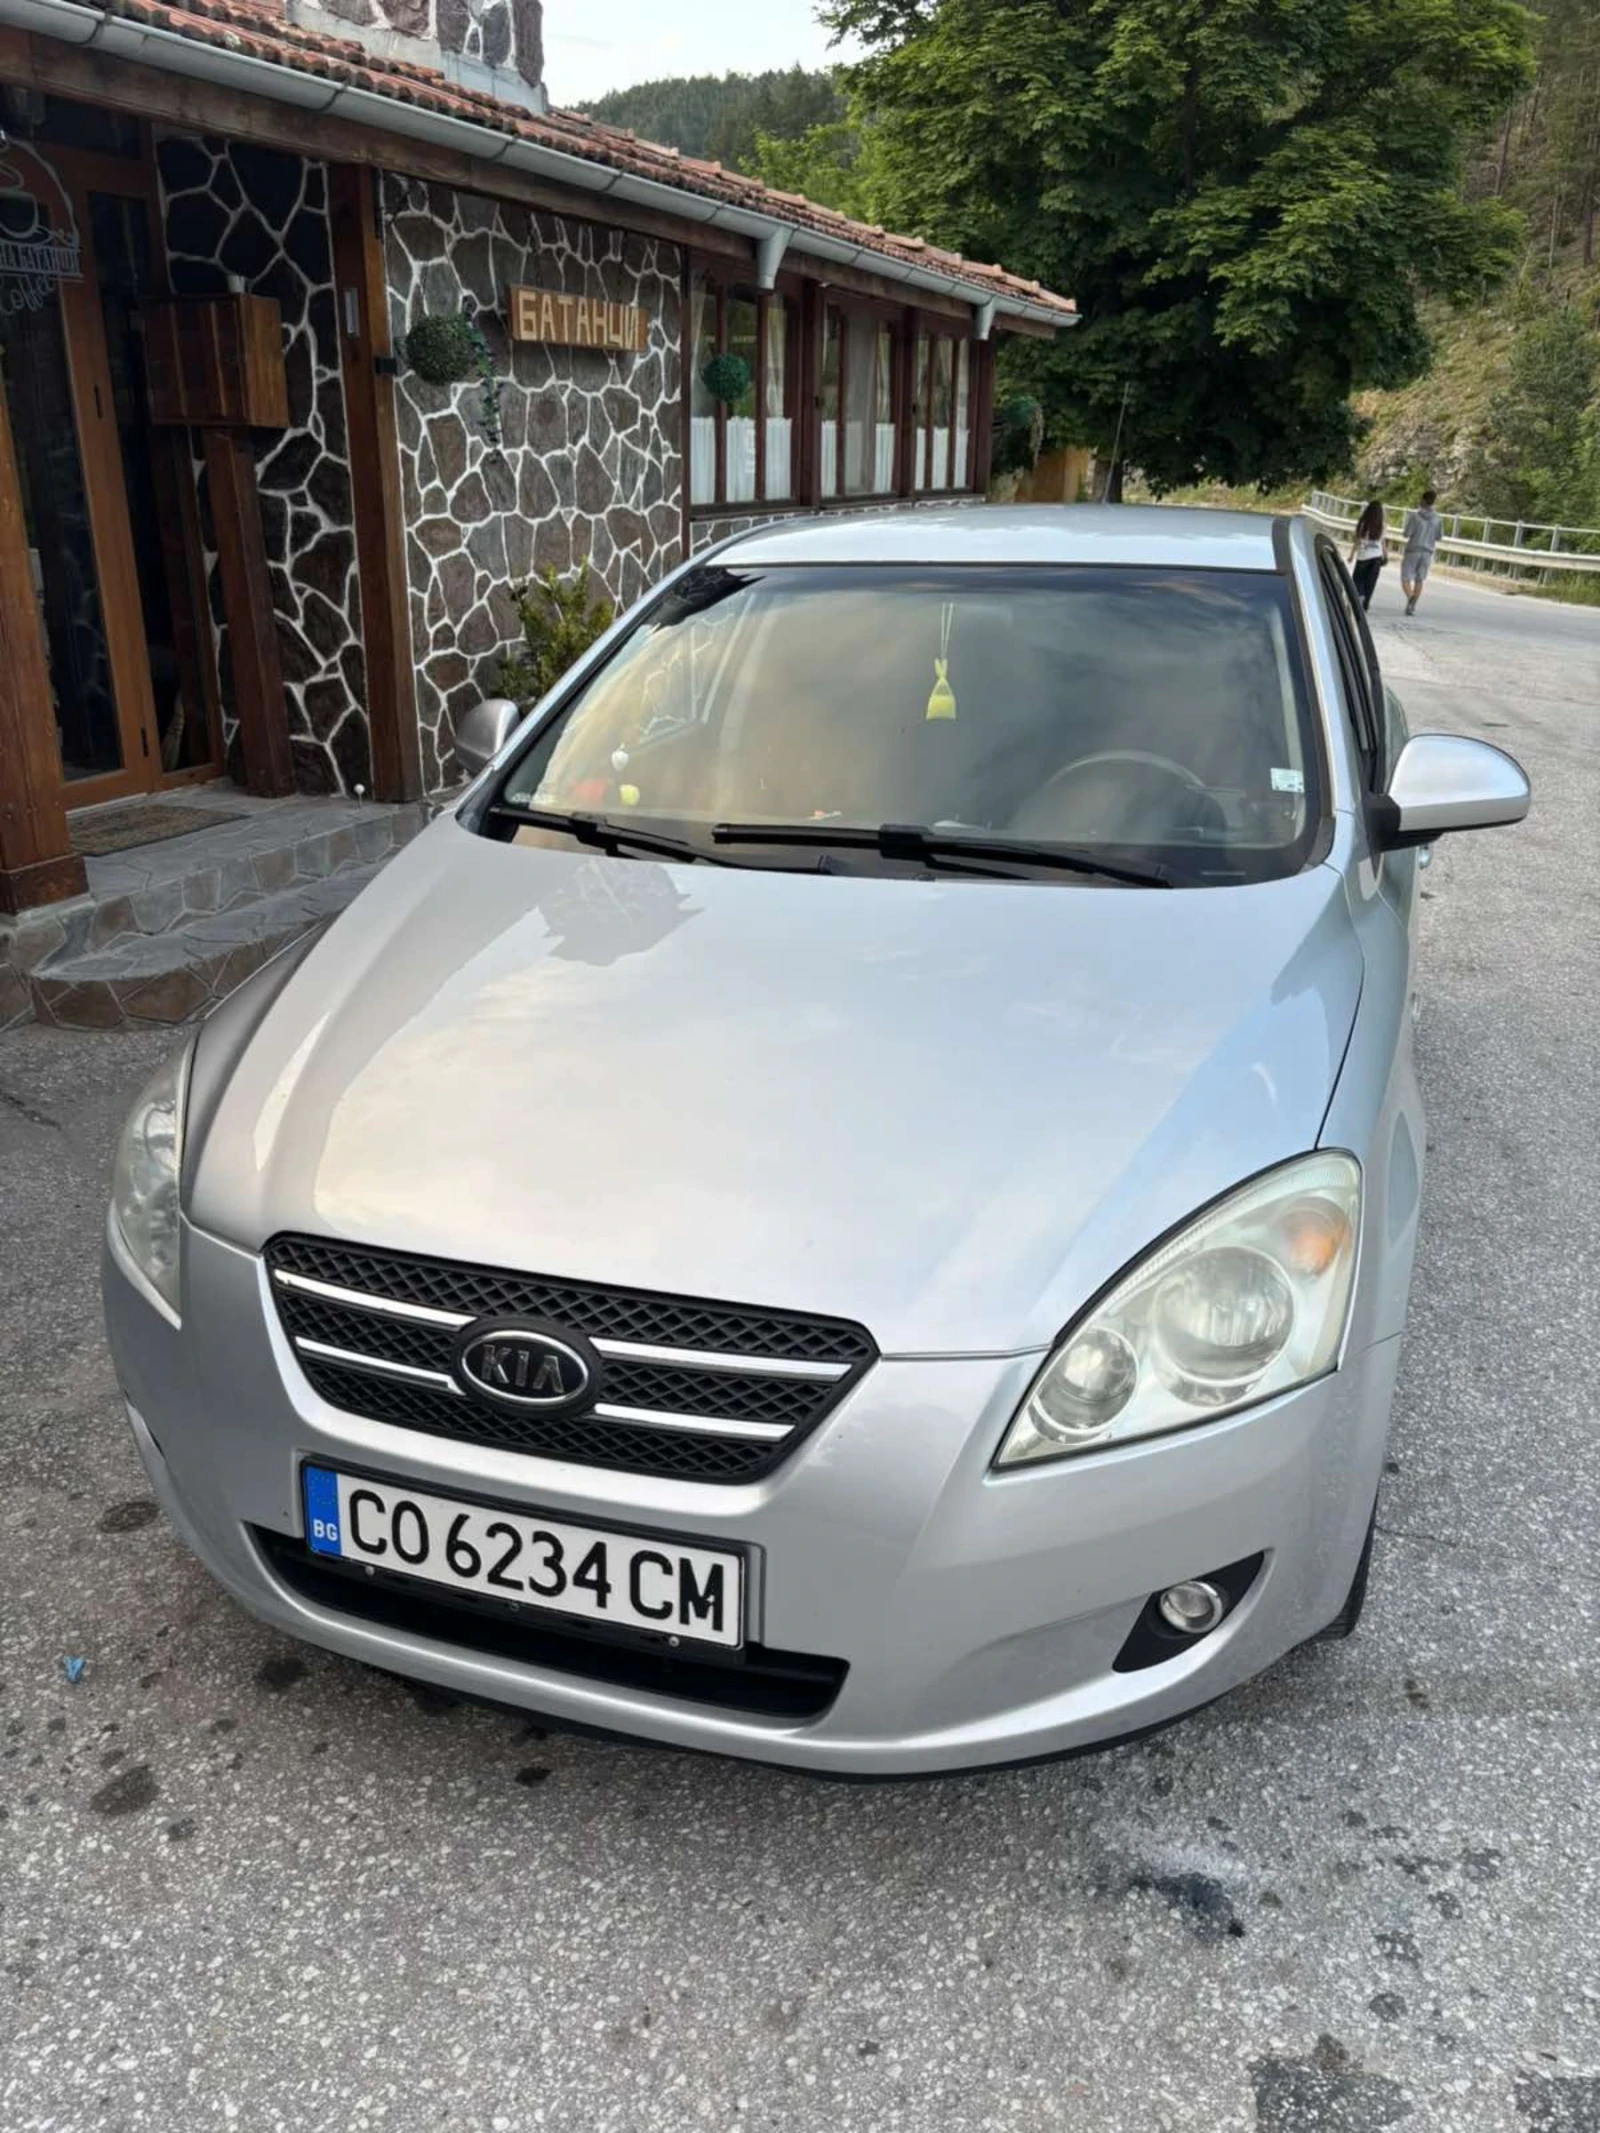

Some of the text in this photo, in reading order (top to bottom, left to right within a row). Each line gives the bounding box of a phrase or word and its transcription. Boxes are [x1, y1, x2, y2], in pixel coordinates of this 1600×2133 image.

[518, 289, 640, 350] БАТАНЦИ
[481, 1343, 565, 1394] KIA
[312, 1517, 338, 1541] BG
[445, 1512, 612, 1609] 6234
[629, 1549, 725, 1632] CM
